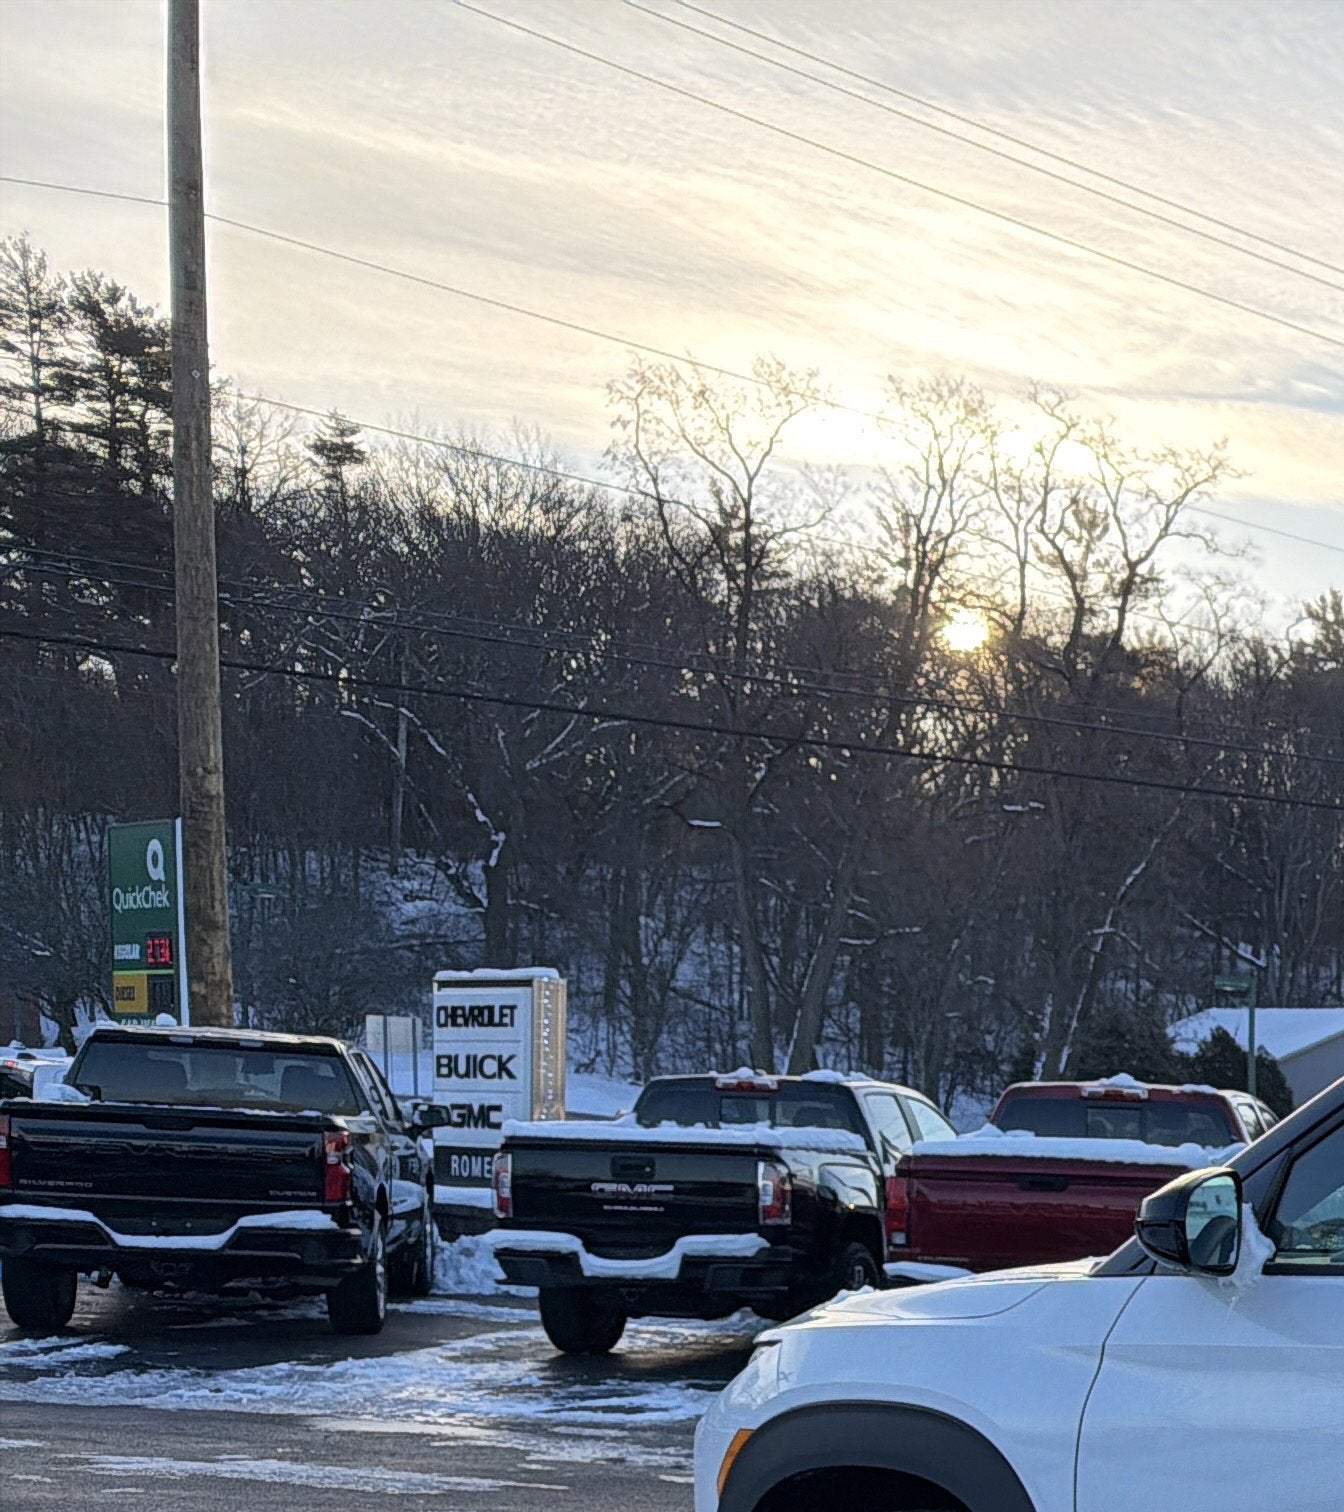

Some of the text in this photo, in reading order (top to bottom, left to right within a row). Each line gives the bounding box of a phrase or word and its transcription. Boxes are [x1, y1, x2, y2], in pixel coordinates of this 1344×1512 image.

[146, 838, 165, 882] Q
[113, 885, 170, 914] QuickChek
[436, 1004, 518, 1028] CHEVROLET
[435, 1054, 517, 1080] BUICK
[449, 1103, 503, 1130] GMC
[450, 1154, 493, 1179] ROME
